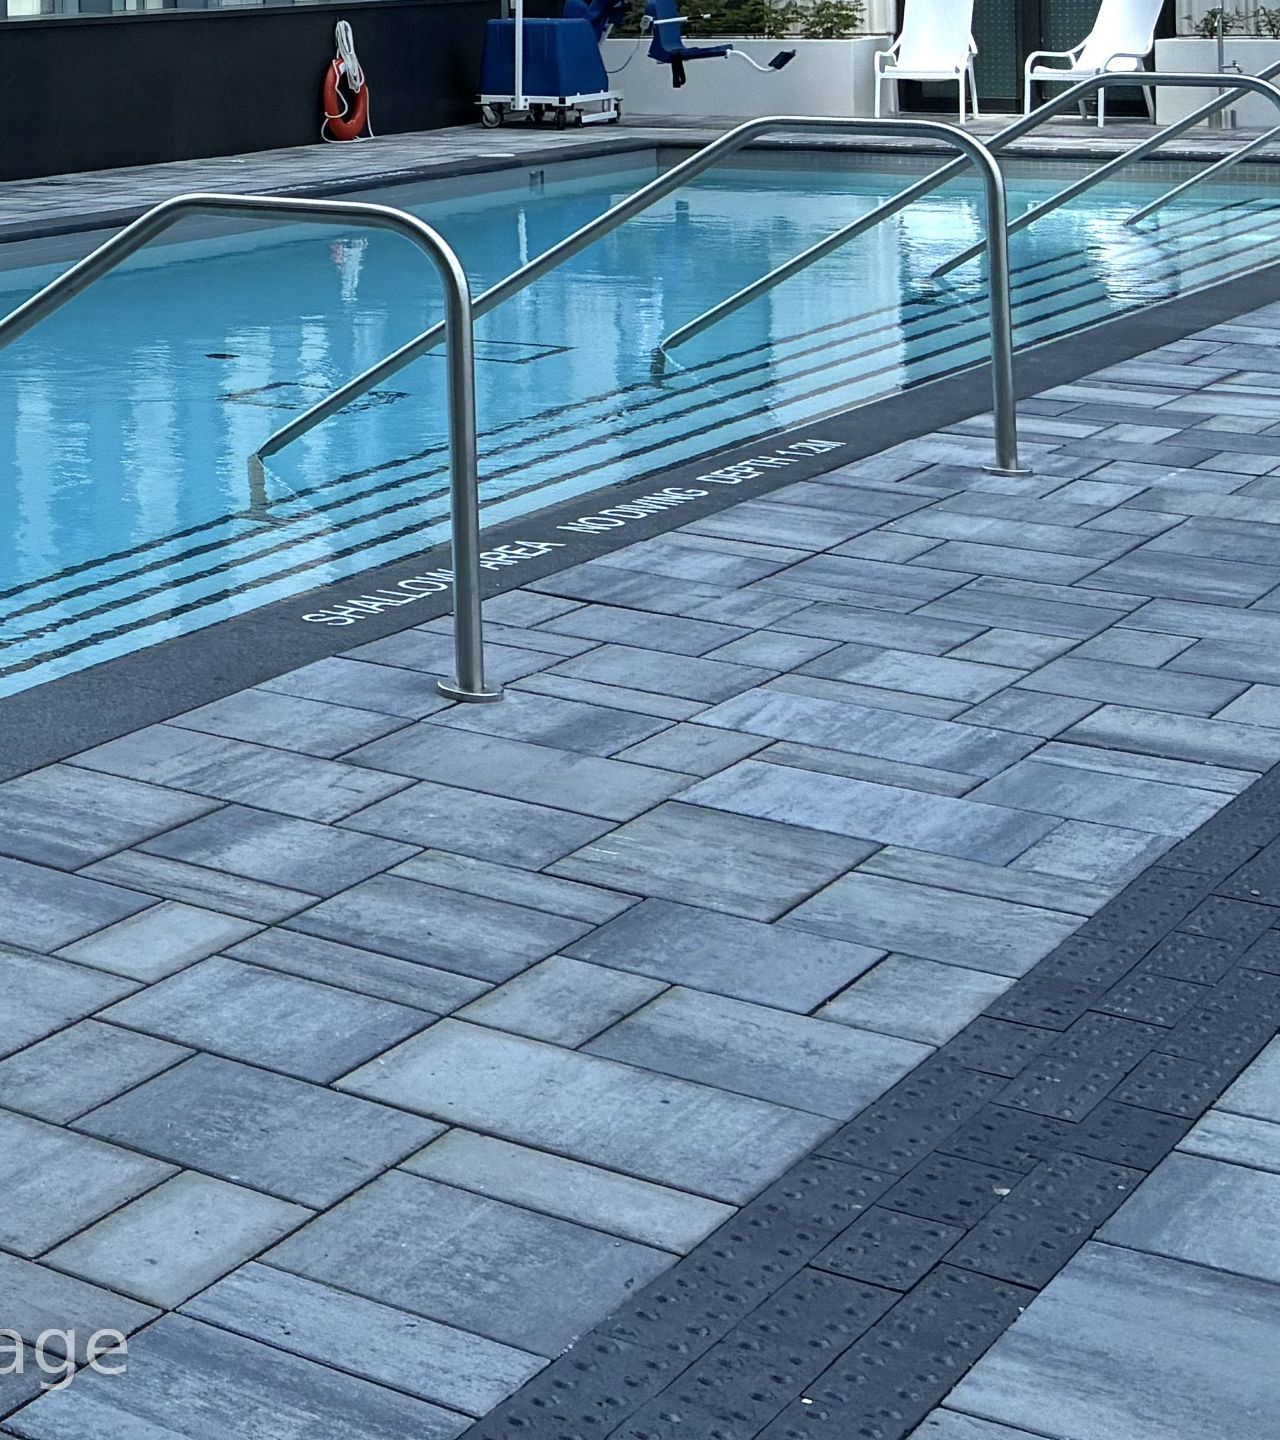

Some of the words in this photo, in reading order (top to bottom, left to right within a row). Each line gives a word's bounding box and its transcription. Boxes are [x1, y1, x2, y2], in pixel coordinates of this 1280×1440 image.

[302, 568, 455, 627] SHALLOW
[479, 540, 566, 571] AREA
[556, 516, 626, 535] NO
[604, 487, 710, 520] DIVING
[695, 455, 790, 485] DEPTH
[775, 439, 847, 464] 1.2M
